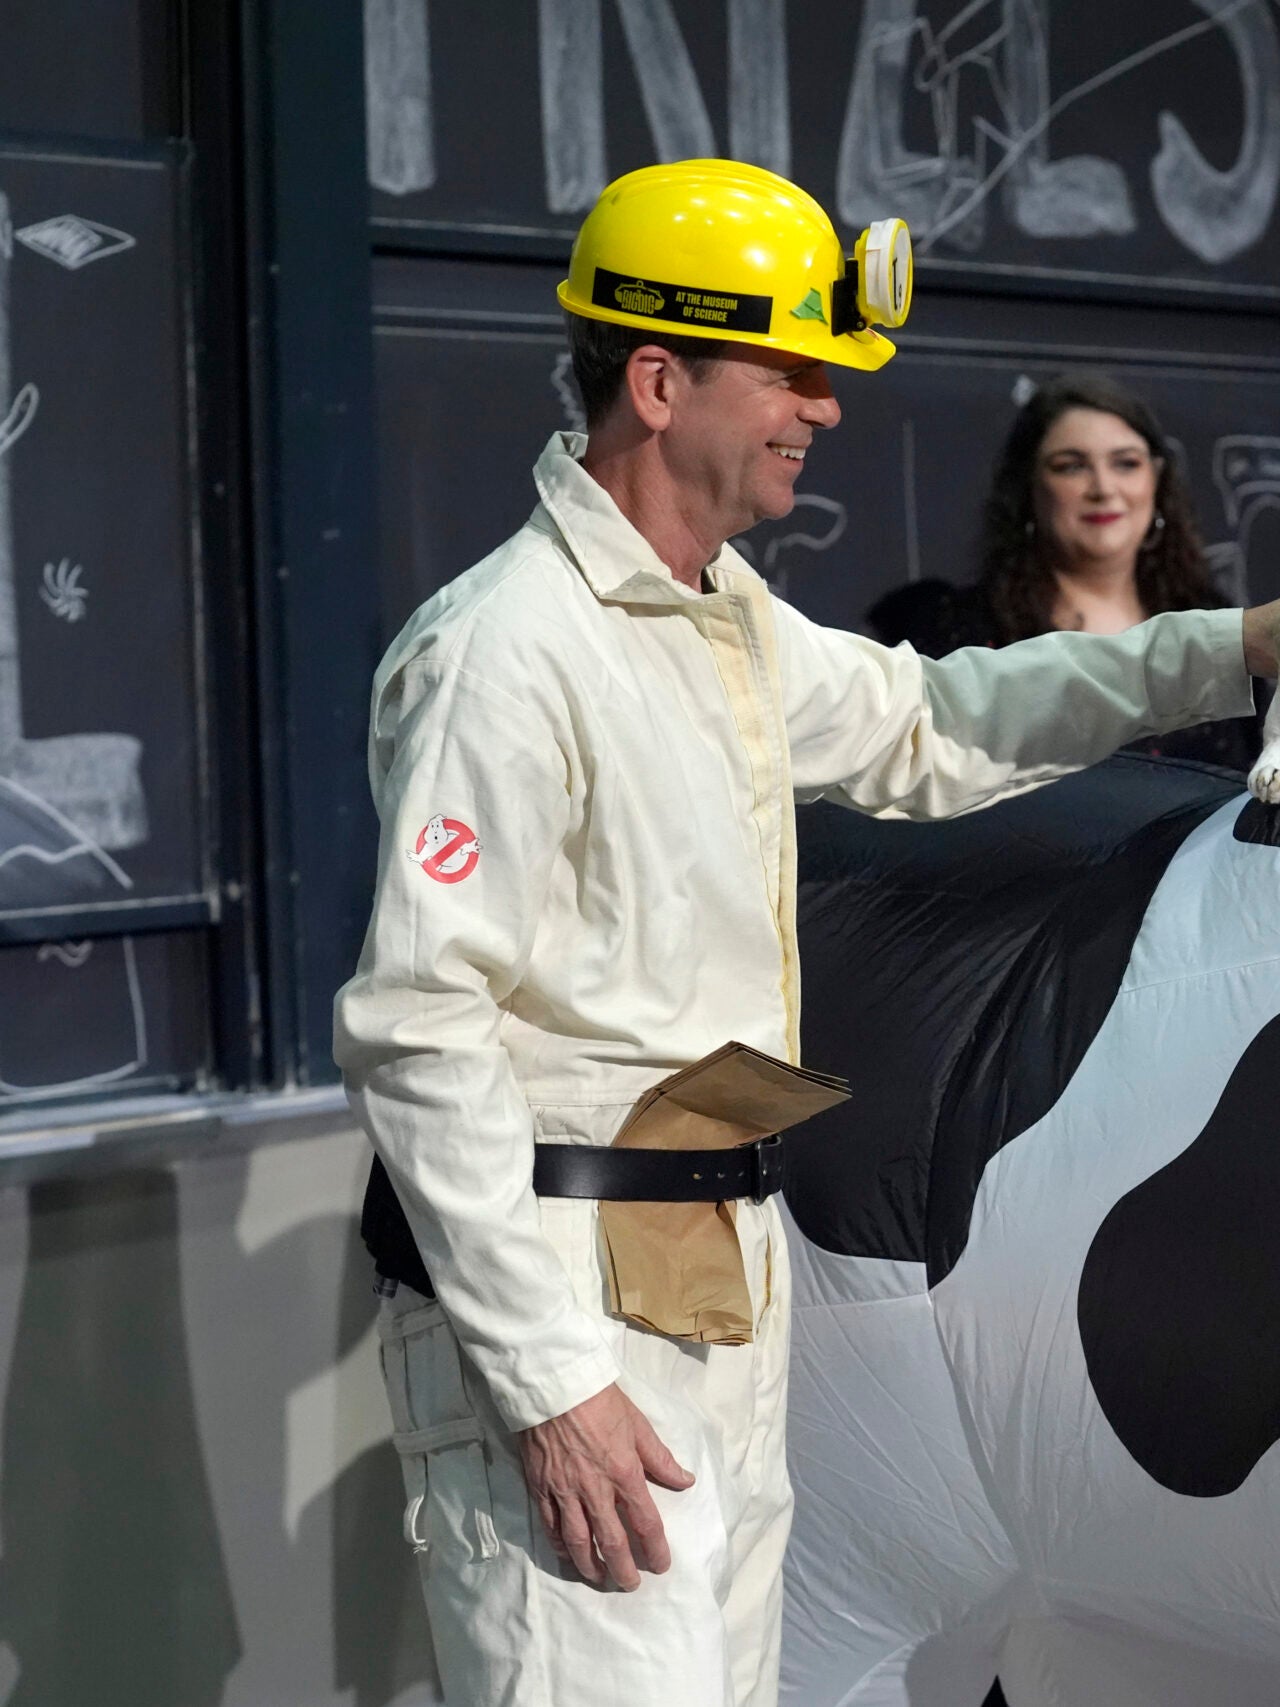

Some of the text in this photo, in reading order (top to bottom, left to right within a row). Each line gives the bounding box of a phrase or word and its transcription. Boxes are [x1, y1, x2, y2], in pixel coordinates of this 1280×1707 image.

[675, 291, 738, 311] AT THE MUSEUM
[683, 305, 728, 323] OF SCIENCE
